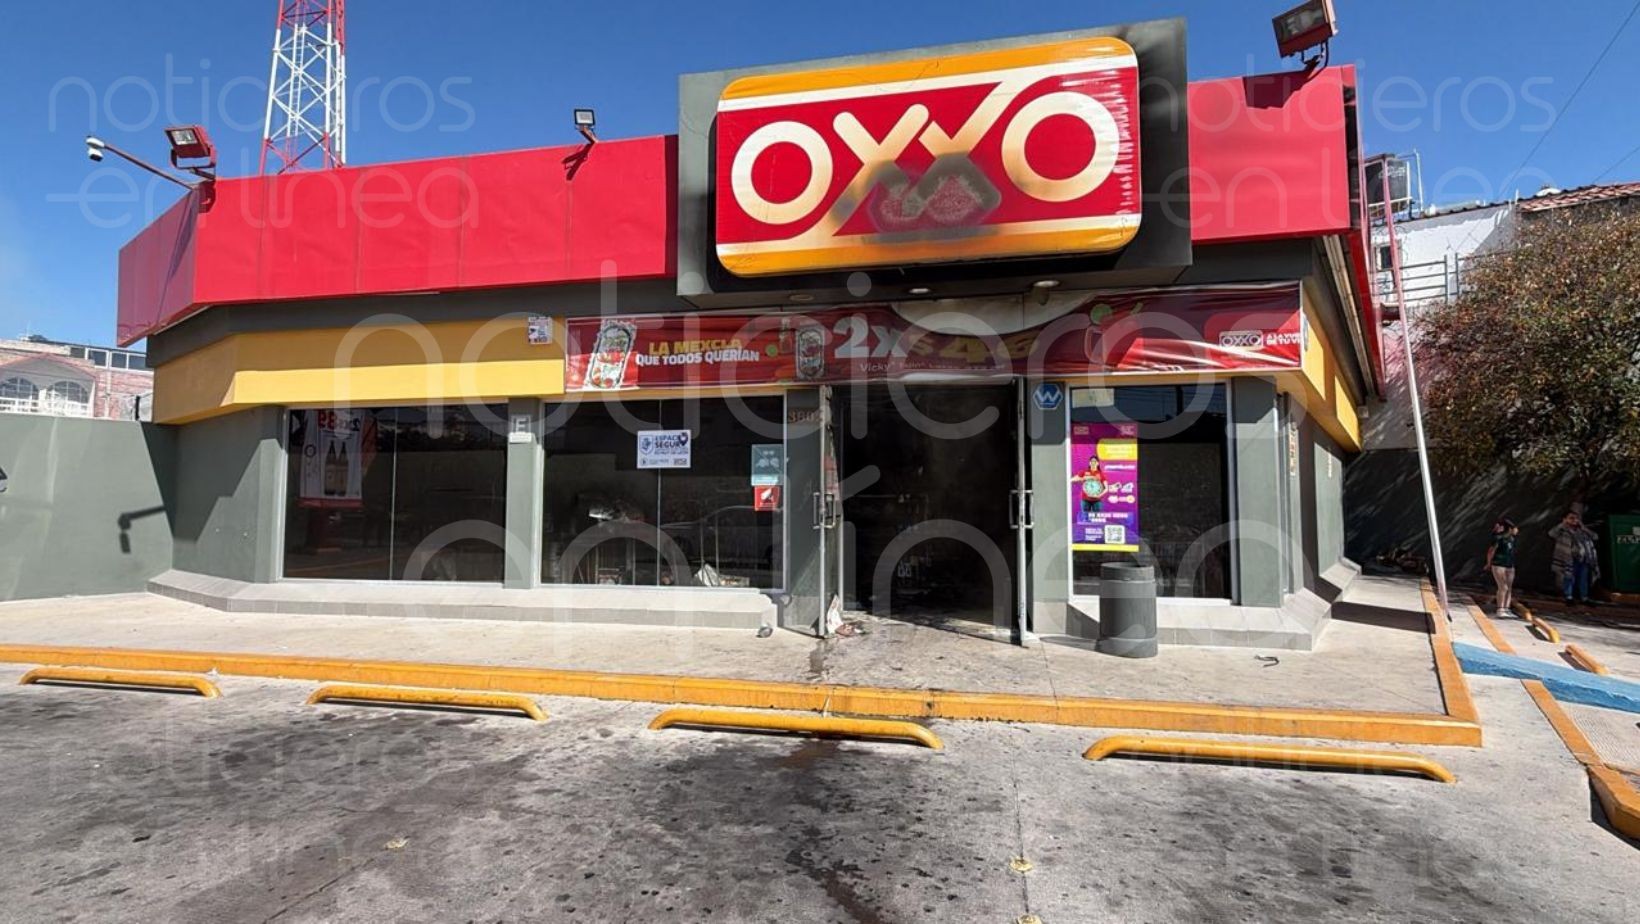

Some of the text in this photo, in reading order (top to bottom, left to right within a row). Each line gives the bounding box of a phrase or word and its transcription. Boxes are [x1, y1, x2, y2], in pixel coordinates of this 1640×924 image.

[730, 62, 1121, 240] OXXO
[648, 338, 742, 356] LA MEXCLA
[1221, 333, 1261, 347] OXXO
[636, 353, 660, 366] QUE
[662, 351, 703, 365] TODOS
